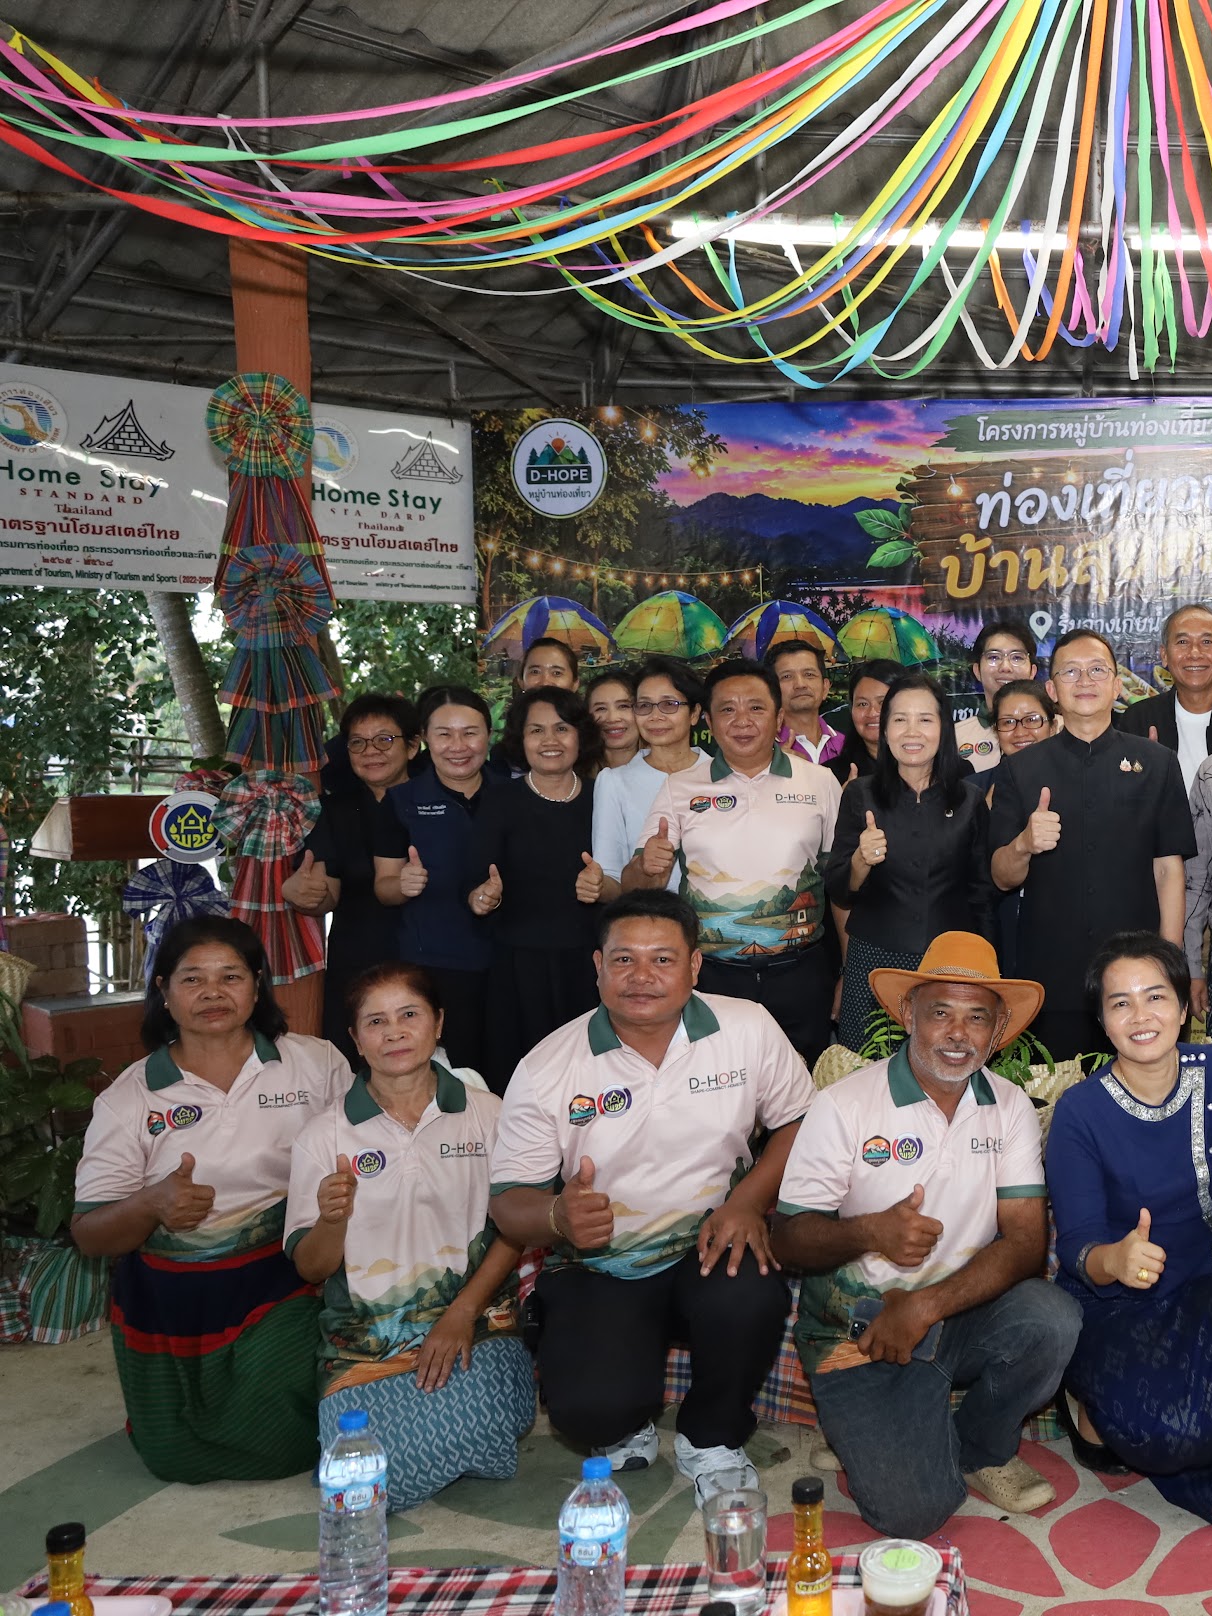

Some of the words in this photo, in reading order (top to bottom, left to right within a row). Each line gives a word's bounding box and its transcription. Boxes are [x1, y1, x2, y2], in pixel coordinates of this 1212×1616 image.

[530, 469, 589, 482] D-HOPE
[19, 487, 143, 504] STANDARD
[312, 482, 381, 506] Home
[388, 488, 442, 515] Stay
[528, 485, 591, 503] หมู่บ้านท่องเที่ยว
[54, 503, 112, 516] Thailand
[35, 567, 43, 577] of
[44, 568, 73, 579] Tourism,
[75, 569, 103, 581] Ministry
[105, 571, 113, 580] of
[114, 572, 140, 581] Tourism
[142, 573, 154, 582] and
[156, 574, 178, 584] Sports
[775, 793, 817, 802] D-HOPE
[689, 1068, 747, 1090] D-HOPE
[258, 1091, 309, 1105] D-HOPE
